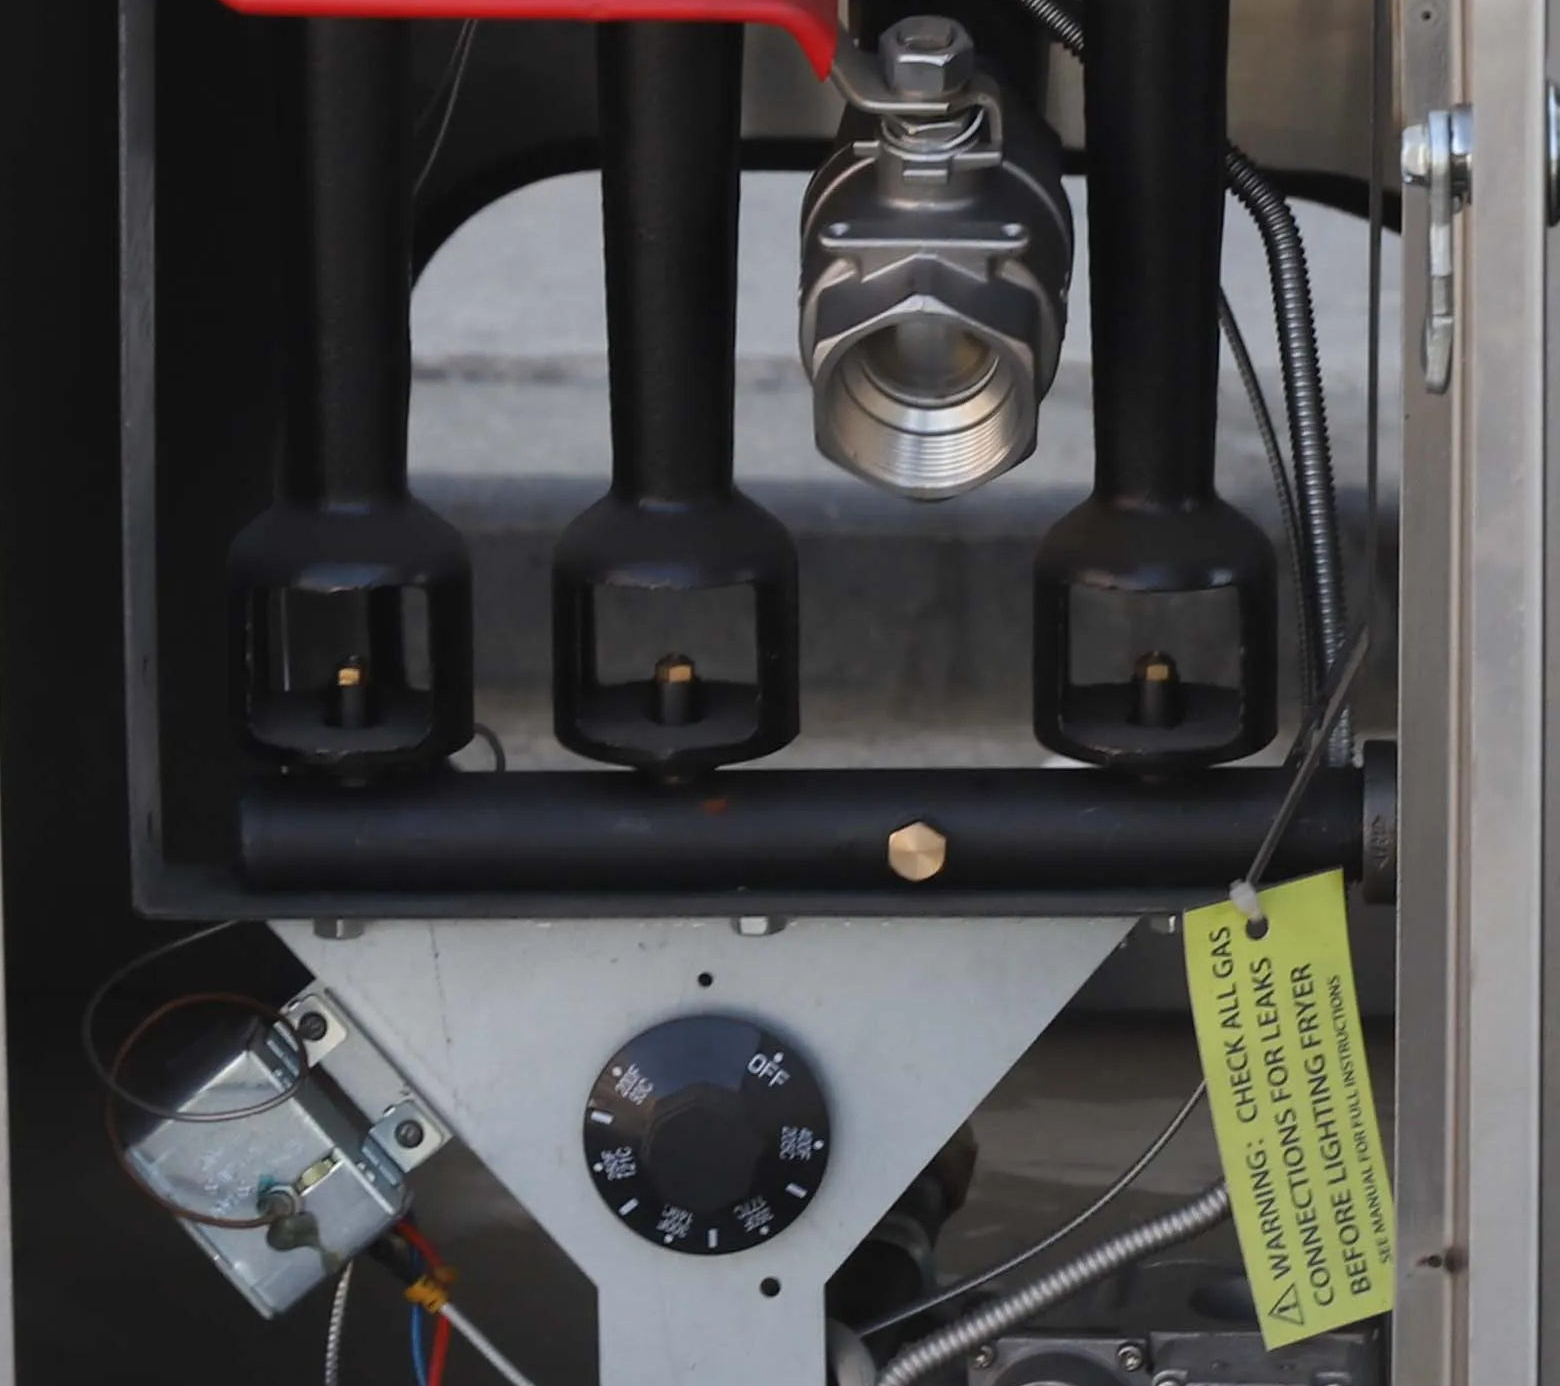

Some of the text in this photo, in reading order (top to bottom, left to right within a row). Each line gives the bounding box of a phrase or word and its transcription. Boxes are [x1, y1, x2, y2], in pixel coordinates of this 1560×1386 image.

[747, 1053, 790, 1087] OFF
[1327, 975, 1356, 1087] INSTRUCTIONS
[1209, 926, 1292, 1281] WARNING: CHECK ALL GAS
[1250, 957, 1335, 1306] CONNECTIONS FOR LEAKS
[1290, 962, 1371, 1295] BEFORE LIGHTING FRYER
[1346, 1089, 1363, 1128] FULL
[1354, 1130, 1371, 1163] FOR
[1361, 1165, 1385, 1234] MANUAL
